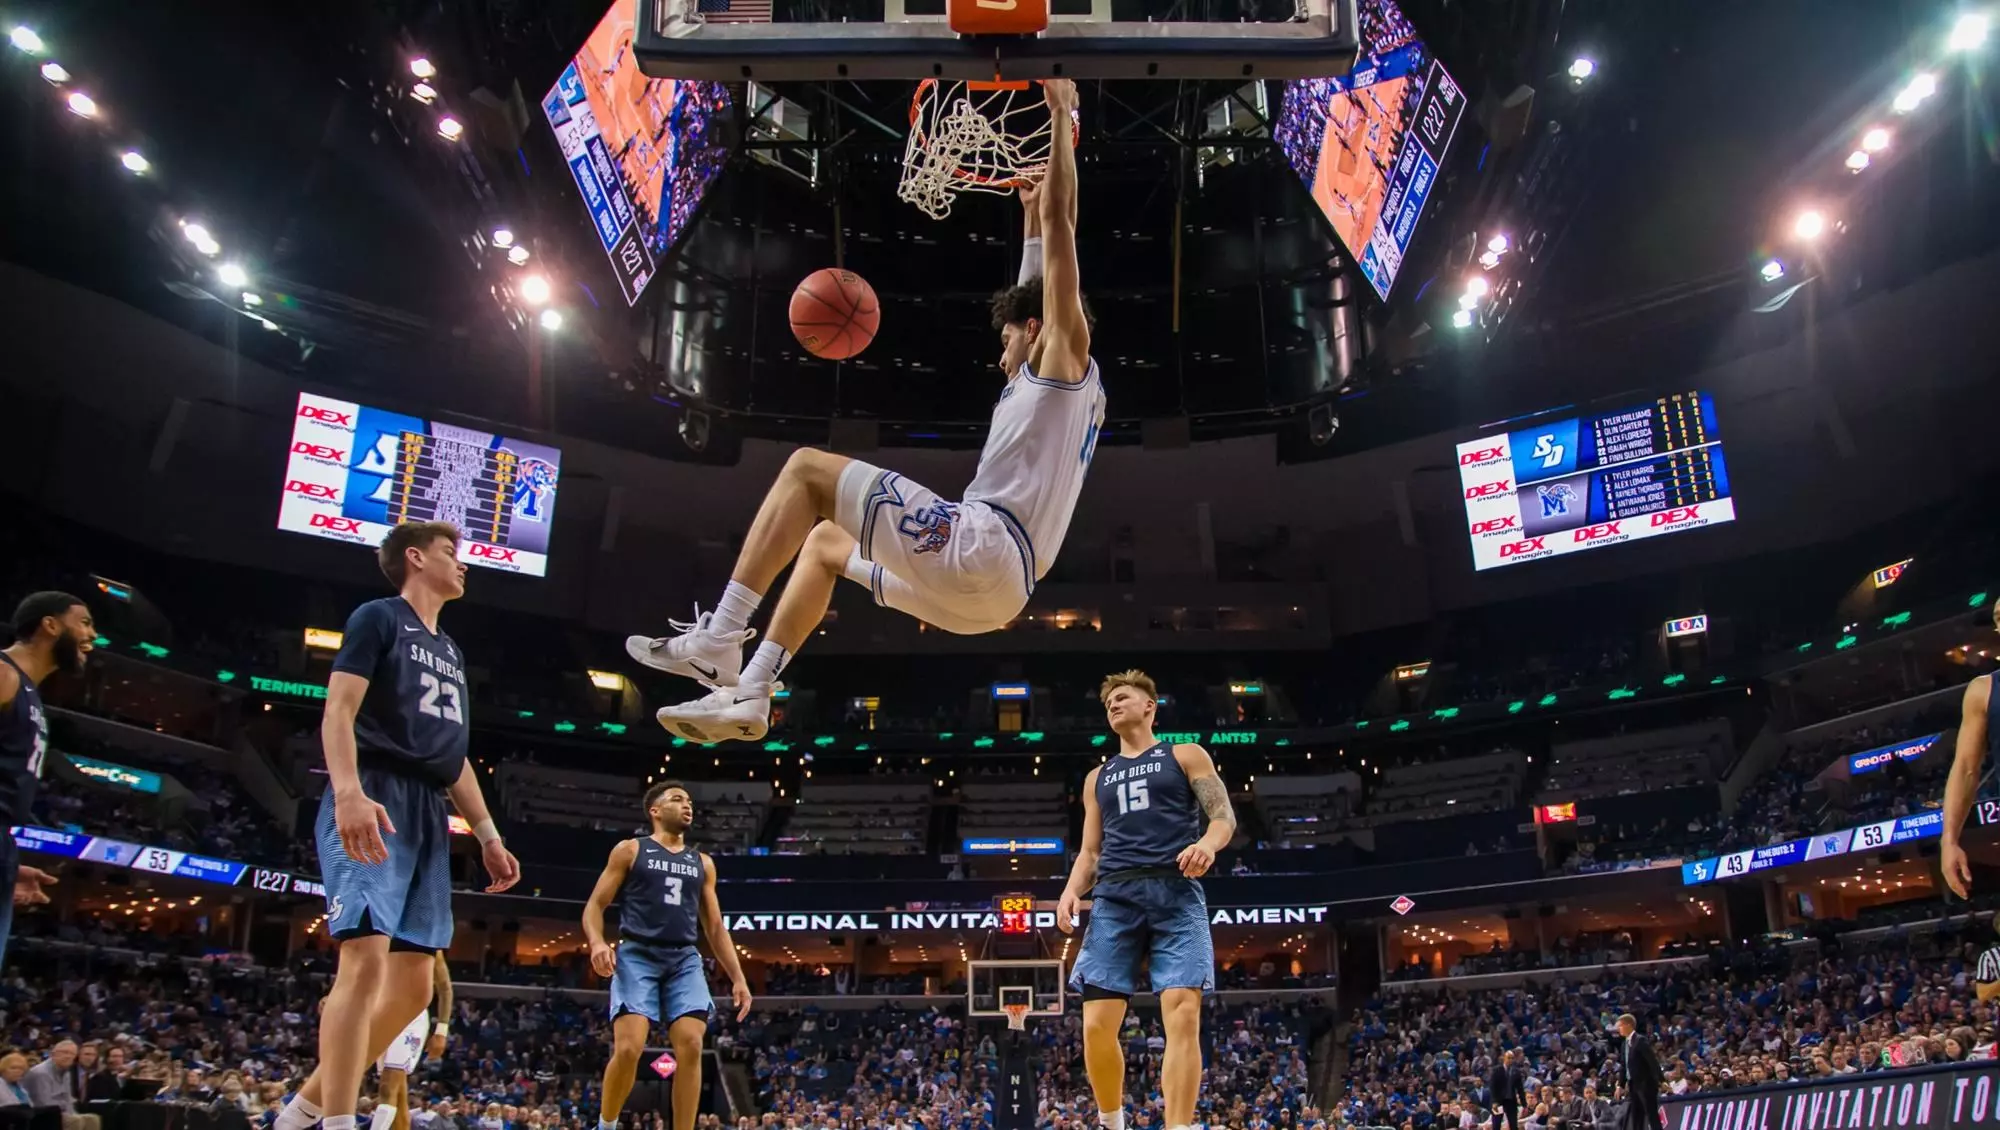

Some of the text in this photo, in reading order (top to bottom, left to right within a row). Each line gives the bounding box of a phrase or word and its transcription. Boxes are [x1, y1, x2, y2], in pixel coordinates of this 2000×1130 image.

[299, 405, 352, 426] DEX
[1602, 415, 1621, 427] TYLER
[1621, 408, 1652, 422] WILLIAMS
[1619, 420, 1643, 432] CARTER
[1597, 447, 1606, 456] 22
[1607, 443, 1628, 454] ISAIAH
[1628, 437, 1652, 449] WRIGHT
[1606, 434, 1621, 446] ALEX
[1621, 428, 1653, 441] FLORESCA
[292, 441, 346, 461] DEX
[1460, 445, 1504, 466] DEX
[1609, 453, 1624, 463] FINN
[1623, 446, 1653, 460] SULLIVAN
[1471, 456, 1512, 469] imaging
[1612, 470, 1631, 481] TYLER
[1630, 464, 1655, 477] HARRIS
[284, 480, 340, 500] DEX
[1465, 479, 1510, 500] DEX
[1613, 480, 1629, 490] ALEX
[1629, 475, 1651, 487] LOMAX
[1477, 490, 1519, 503] imaging
[1617, 496, 1647, 508] ANTWANN
[1646, 491, 1666, 502] JONES
[1618, 507, 1639, 517] ISAIAH
[1638, 500, 1667, 513] MAURICE
[1650, 505, 1700, 528] DEX
[309, 513, 362, 534] DEX
[1471, 515, 1516, 535] DEX
[1482, 526, 1524, 538] imaging
[1574, 521, 1622, 543] DEX
[1664, 518, 1708, 532] imaging
[1499, 537, 1545, 558] DEX
[1586, 534, 1629, 547] imaging
[468, 543, 518, 563] DEX
[1511, 549, 1553, 561] imaging
[410, 644, 434, 669] SAN
[418, 672, 463, 725] 23
[1210, 732, 1257, 744] ANTS?
[1103, 762, 1161, 786] SAN DIEGO
[1116, 778, 1150, 815] 15
[1863, 826, 1883, 846] 53
[150, 851, 169, 870] 53
[648, 859, 698, 878] SAN DIEGO
[1727, 856, 1743, 873] 43
[253, 868, 290, 893] 12:27
[293, 880, 311, 893] 2ND
[664, 876, 683, 906] 3
[1680, 1075, 2000, 1130] NATIONAL INVITATION TO
